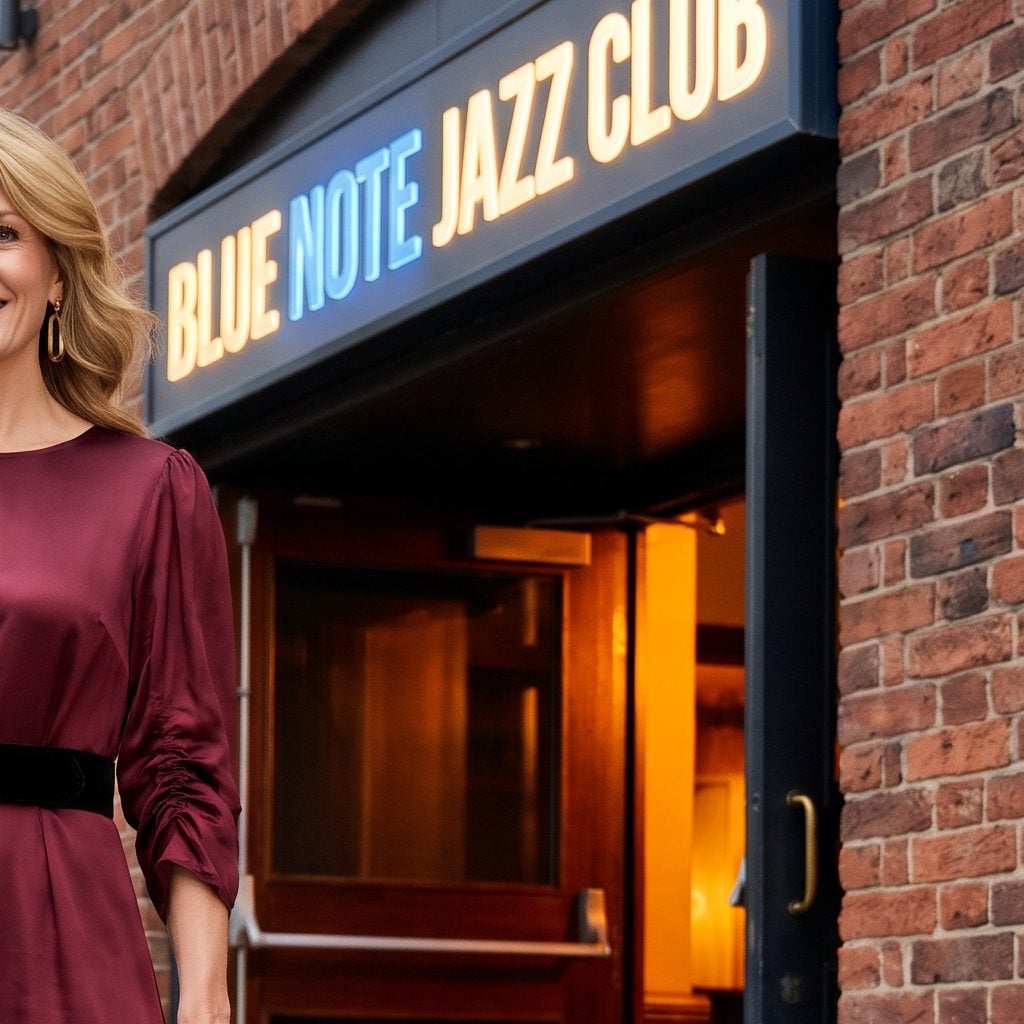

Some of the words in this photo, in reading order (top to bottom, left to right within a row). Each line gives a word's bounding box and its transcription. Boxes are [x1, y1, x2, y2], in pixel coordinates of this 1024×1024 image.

[167, 209, 281, 382] BLUE
[289, 128, 422, 321] NOTE
[432, 40, 574, 248] JAZZ
[587, 0, 767, 164] CLUB
